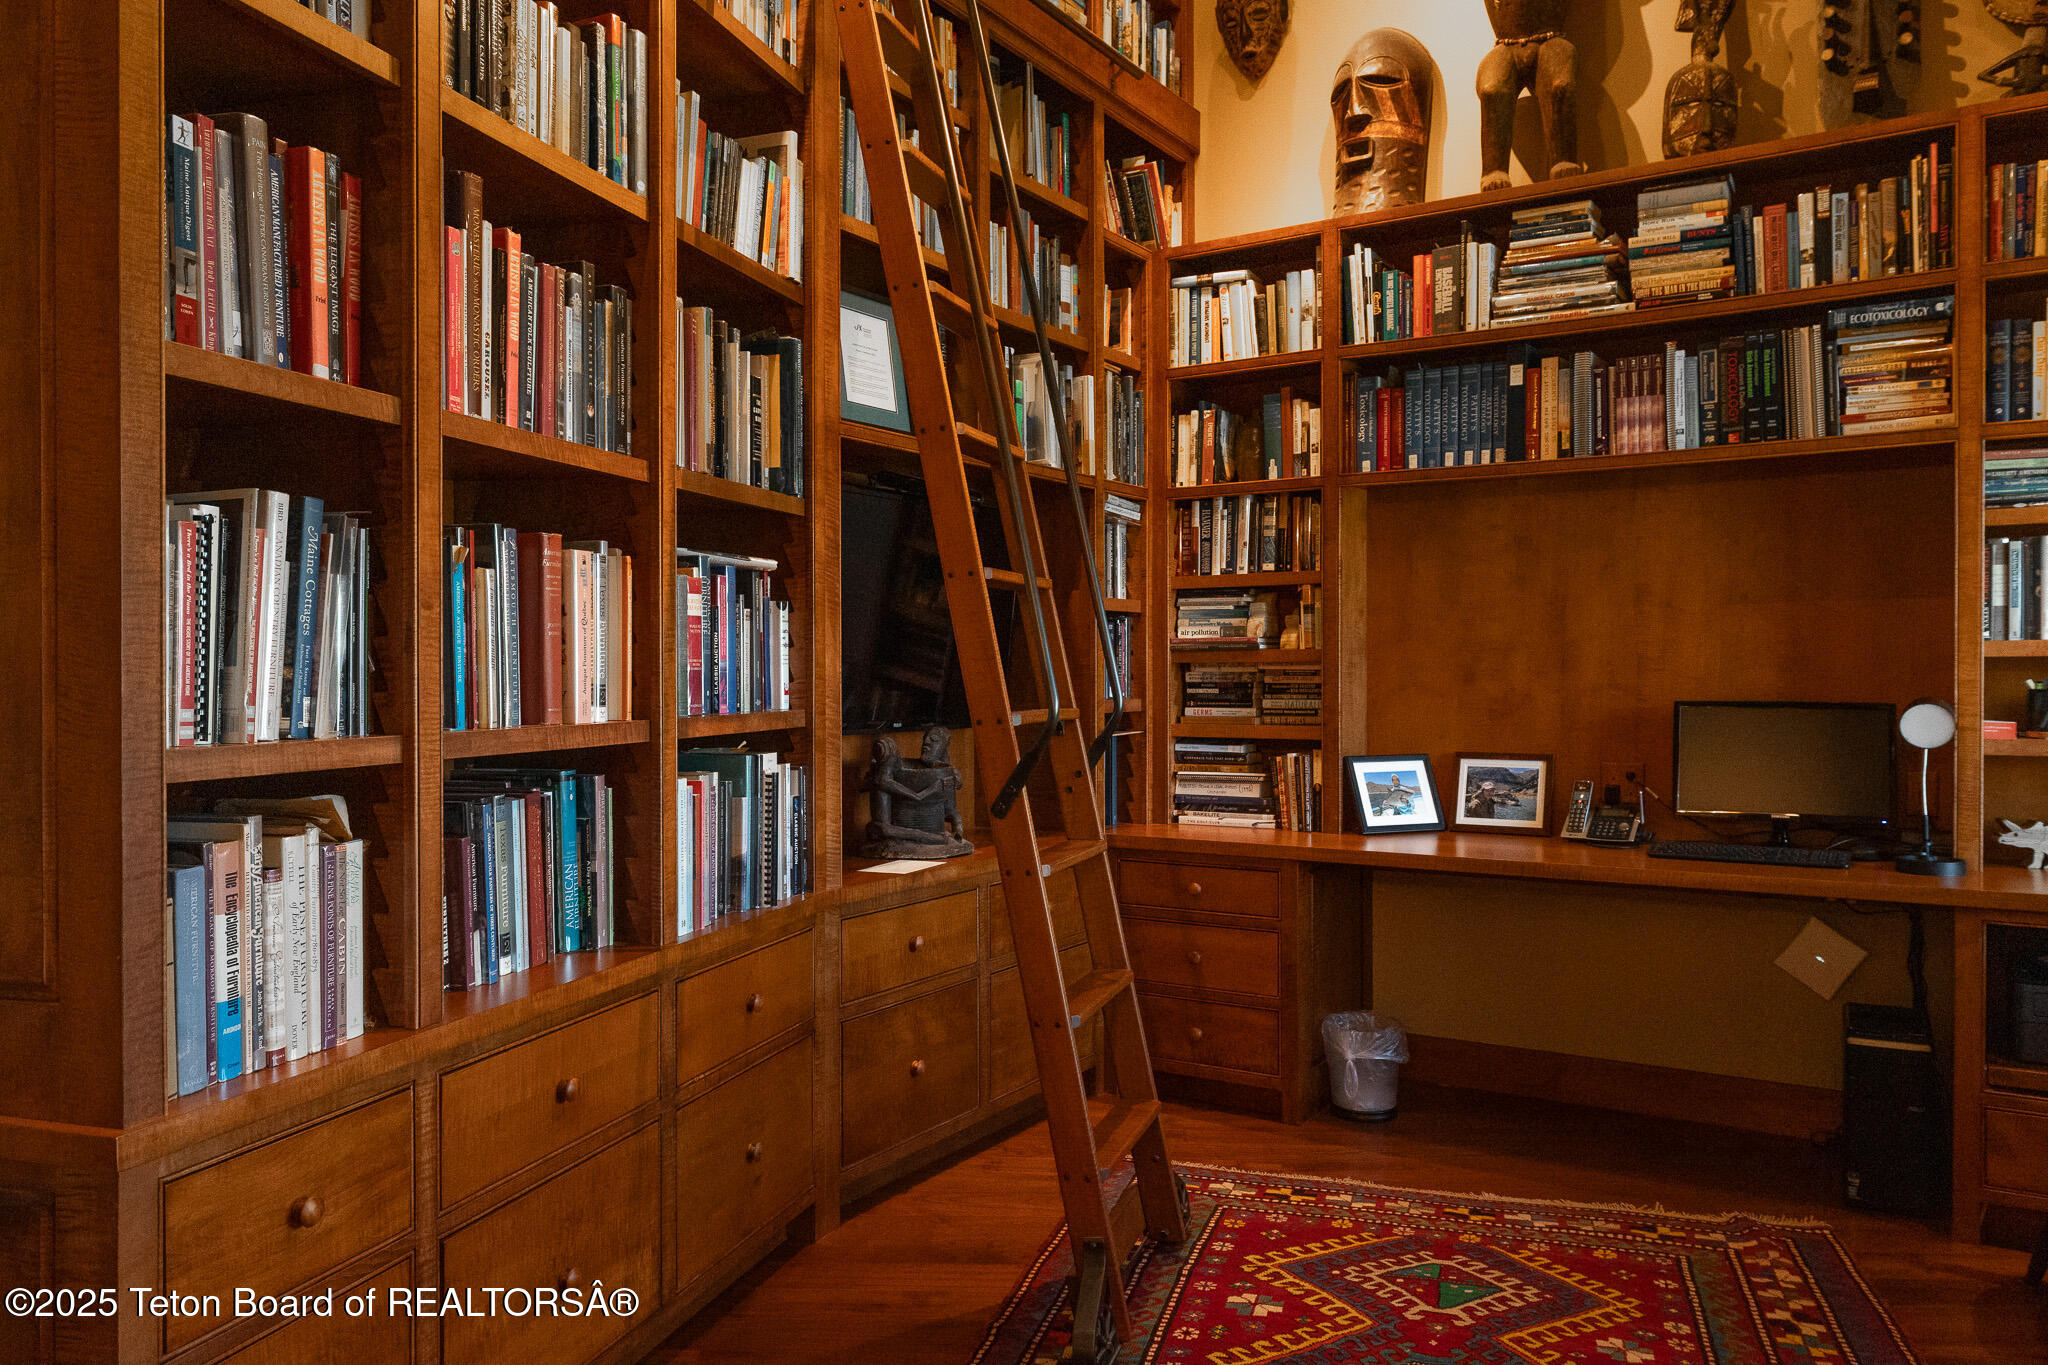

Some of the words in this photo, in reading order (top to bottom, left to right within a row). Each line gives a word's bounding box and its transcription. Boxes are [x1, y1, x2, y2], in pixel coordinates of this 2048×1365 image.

[184, 156, 192, 183] Maine
[256, 150, 264, 165] The
[183, 184, 192, 214] Antique
[205, 175, 213, 211] American
[256, 167, 265, 202] Heritage
[270, 169, 280, 215] AMERICAN
[312, 169, 325, 227] ARTISTS
[206, 214, 214, 230] Folk
[258, 203, 266, 213] of
[259, 214, 267, 237] UPPER
[349, 194, 360, 249] ARTISTS
[184, 215, 192, 241] Digest
[206, 233, 214, 248] Art
[313, 229, 325, 243] IN
[330, 221, 338, 243] THE
[1687, 228, 1716, 238] BUNTS
[260, 238, 269, 278] CANADIAN
[271, 216, 283, 287] MANUFACTURED
[313, 248, 326, 284] WOOD
[349, 250, 360, 263] IN
[206, 259, 216, 283] Wendy
[329, 246, 338, 298] ELEGANT
[349, 268, 360, 302] WOOD
[510, 247, 519, 295] ARTISTS
[207, 287, 216, 313] Lavitt
[261, 278, 270, 326] FURNITURE
[510, 296, 519, 308] IN
[587, 301, 593, 314] OF
[1441, 266, 1453, 314] BASEBALL
[274, 288, 285, 338] FURNITURE
[331, 299, 339, 335] IMAGE
[510, 311, 519, 341] WOOD
[1850, 306, 1929, 324] ECOTOXICOLOGY
[1728, 352, 1738, 423] TOXICOLOGY
[1359, 392, 1368, 443] Toxicology
[1201, 509, 1211, 539] HAMMER
[273, 530, 283, 585] CANADIAN
[307, 525, 319, 574] Maine
[508, 537, 518, 626] PORTSMOUTH
[270, 587, 281, 638] COUNTRY
[299, 579, 316, 636] Cottages
[268, 639, 279, 697] FURNITURE
[250, 842, 263, 875] Early
[499, 827, 507, 862] Texas
[225, 871, 238, 888] The
[327, 881, 335, 899] FINE
[500, 865, 510, 928] Furniture
[564, 863, 574, 928] AMERICAN
[251, 874, 265, 930] American
[291, 902, 299, 910] of
[327, 900, 335, 929] POINTS
[224, 894, 240, 956] Encyclopedia
[291, 913, 299, 936] Early
[327, 930, 335, 941] OF
[209, 941, 215, 951] OF
[226, 957, 240, 969] of
[251, 929, 266, 986] Furniture
[338, 917, 346, 976] CABIN
[292, 959, 301, 994] England
[327, 942, 335, 987] FURNITURE
[226, 970, 241, 1016] Furniture
[299, 942, 307, 1031] FURNITURE
